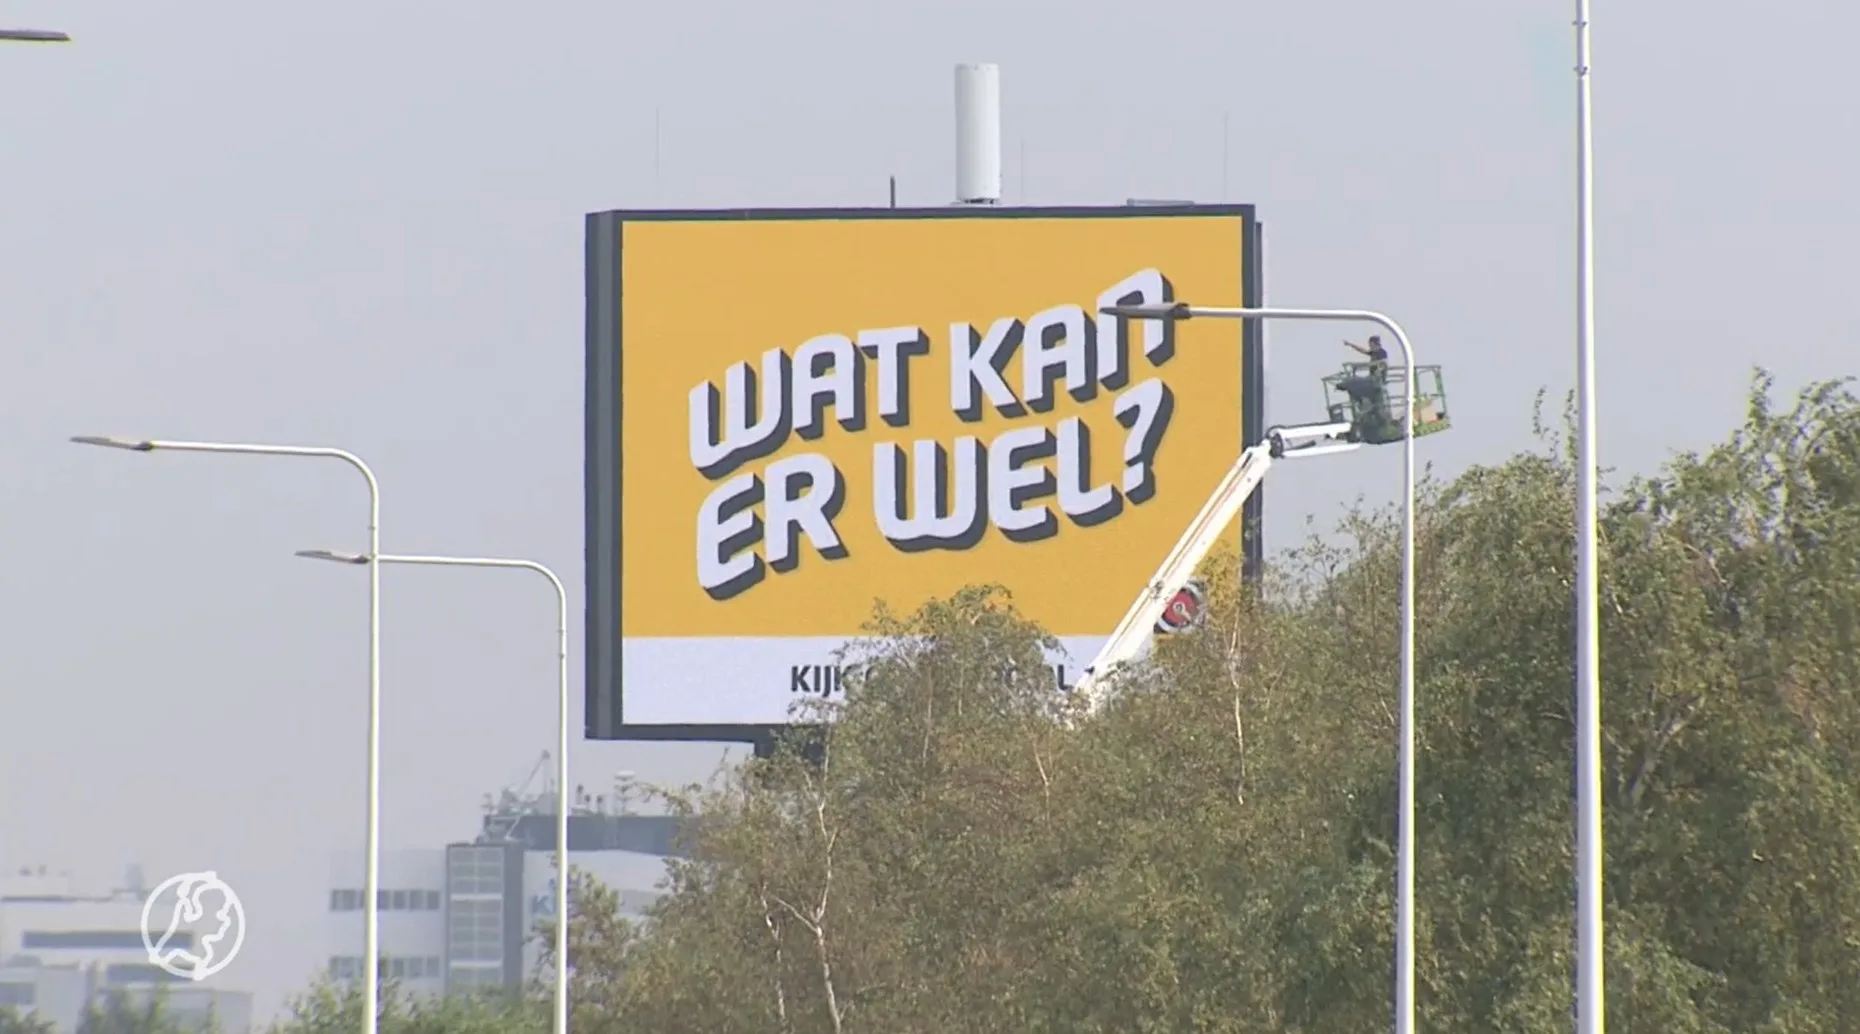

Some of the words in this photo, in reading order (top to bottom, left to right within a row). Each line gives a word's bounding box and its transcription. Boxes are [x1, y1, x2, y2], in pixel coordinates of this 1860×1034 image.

[689, 326, 928, 479] WAT
[949, 267, 1174, 416] KAN
[696, 452, 849, 601] ER
[872, 377, 1174, 552] WEL?
